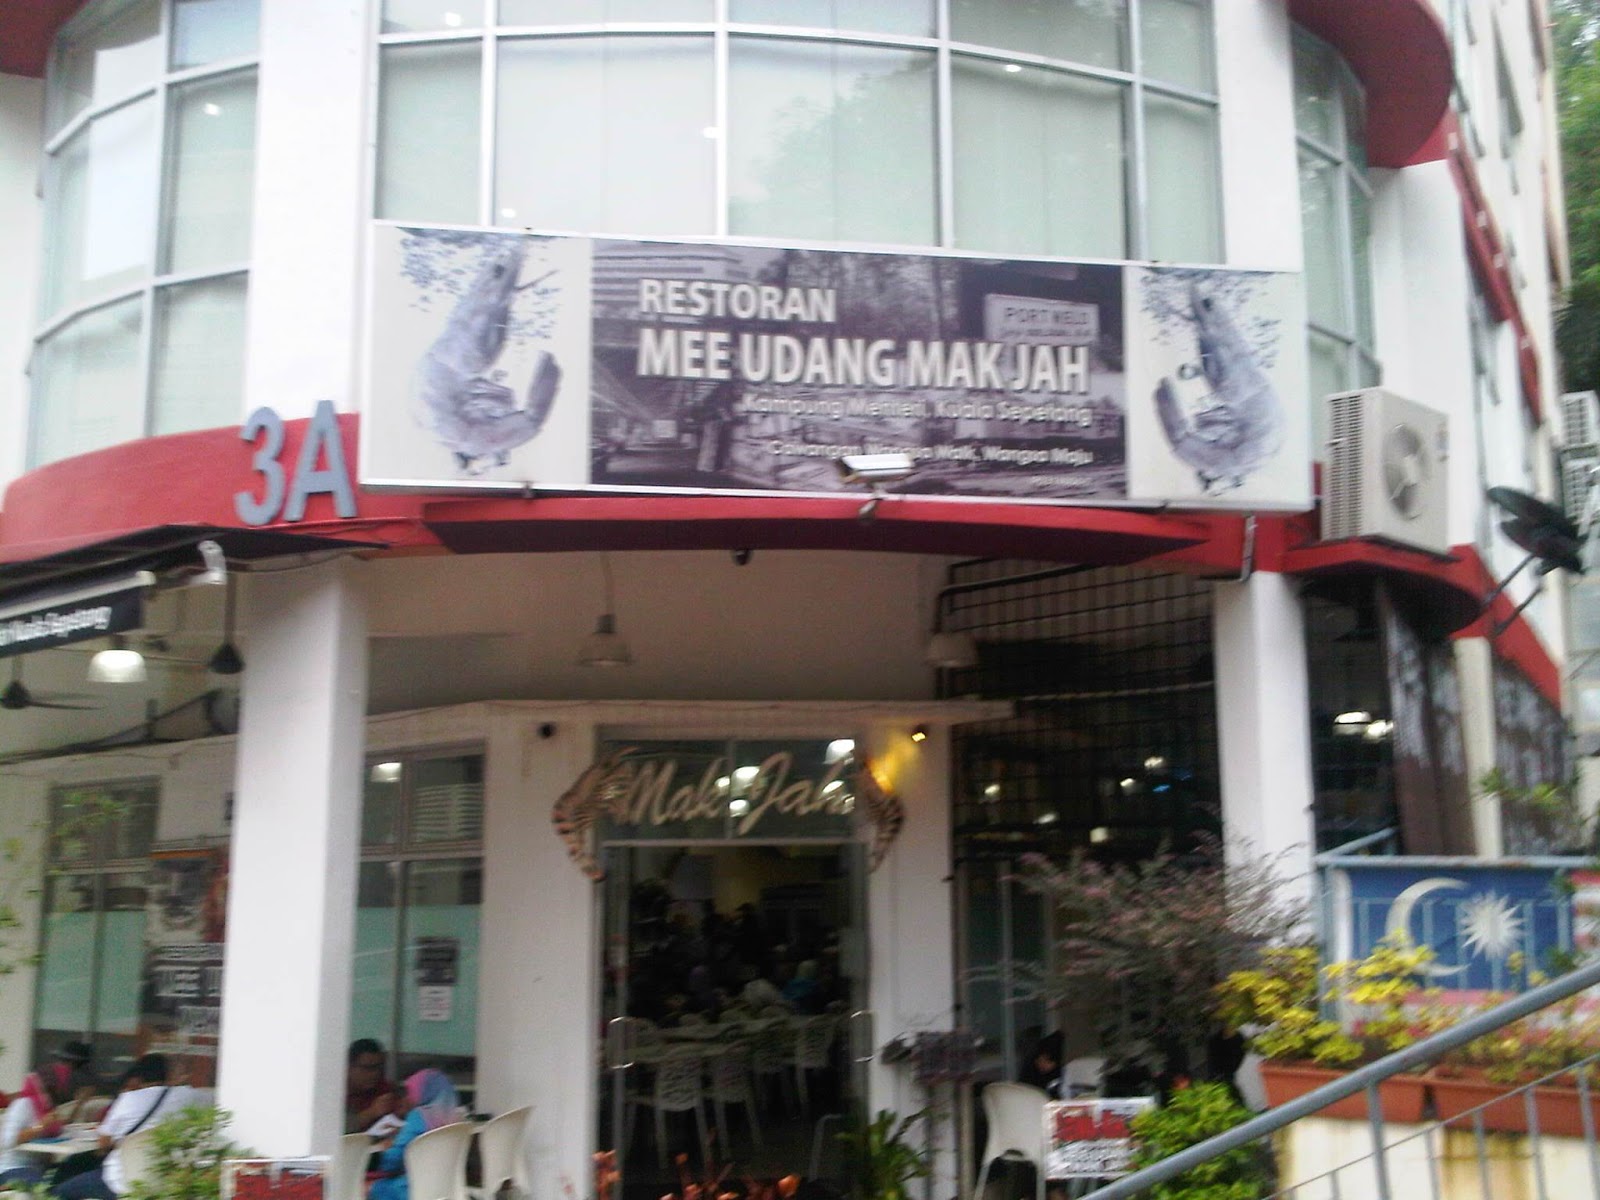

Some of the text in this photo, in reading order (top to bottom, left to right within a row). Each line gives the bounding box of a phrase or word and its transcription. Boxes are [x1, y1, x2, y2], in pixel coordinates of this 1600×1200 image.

[638, 279, 837, 323] RESTORAN
[636, 328, 1090, 393] MEE UDANG MAK JAH
[997, 401, 1092, 427] Sepetang
[233, 399, 358, 526] 3A
[613, 750, 855, 836] Mak Jah
